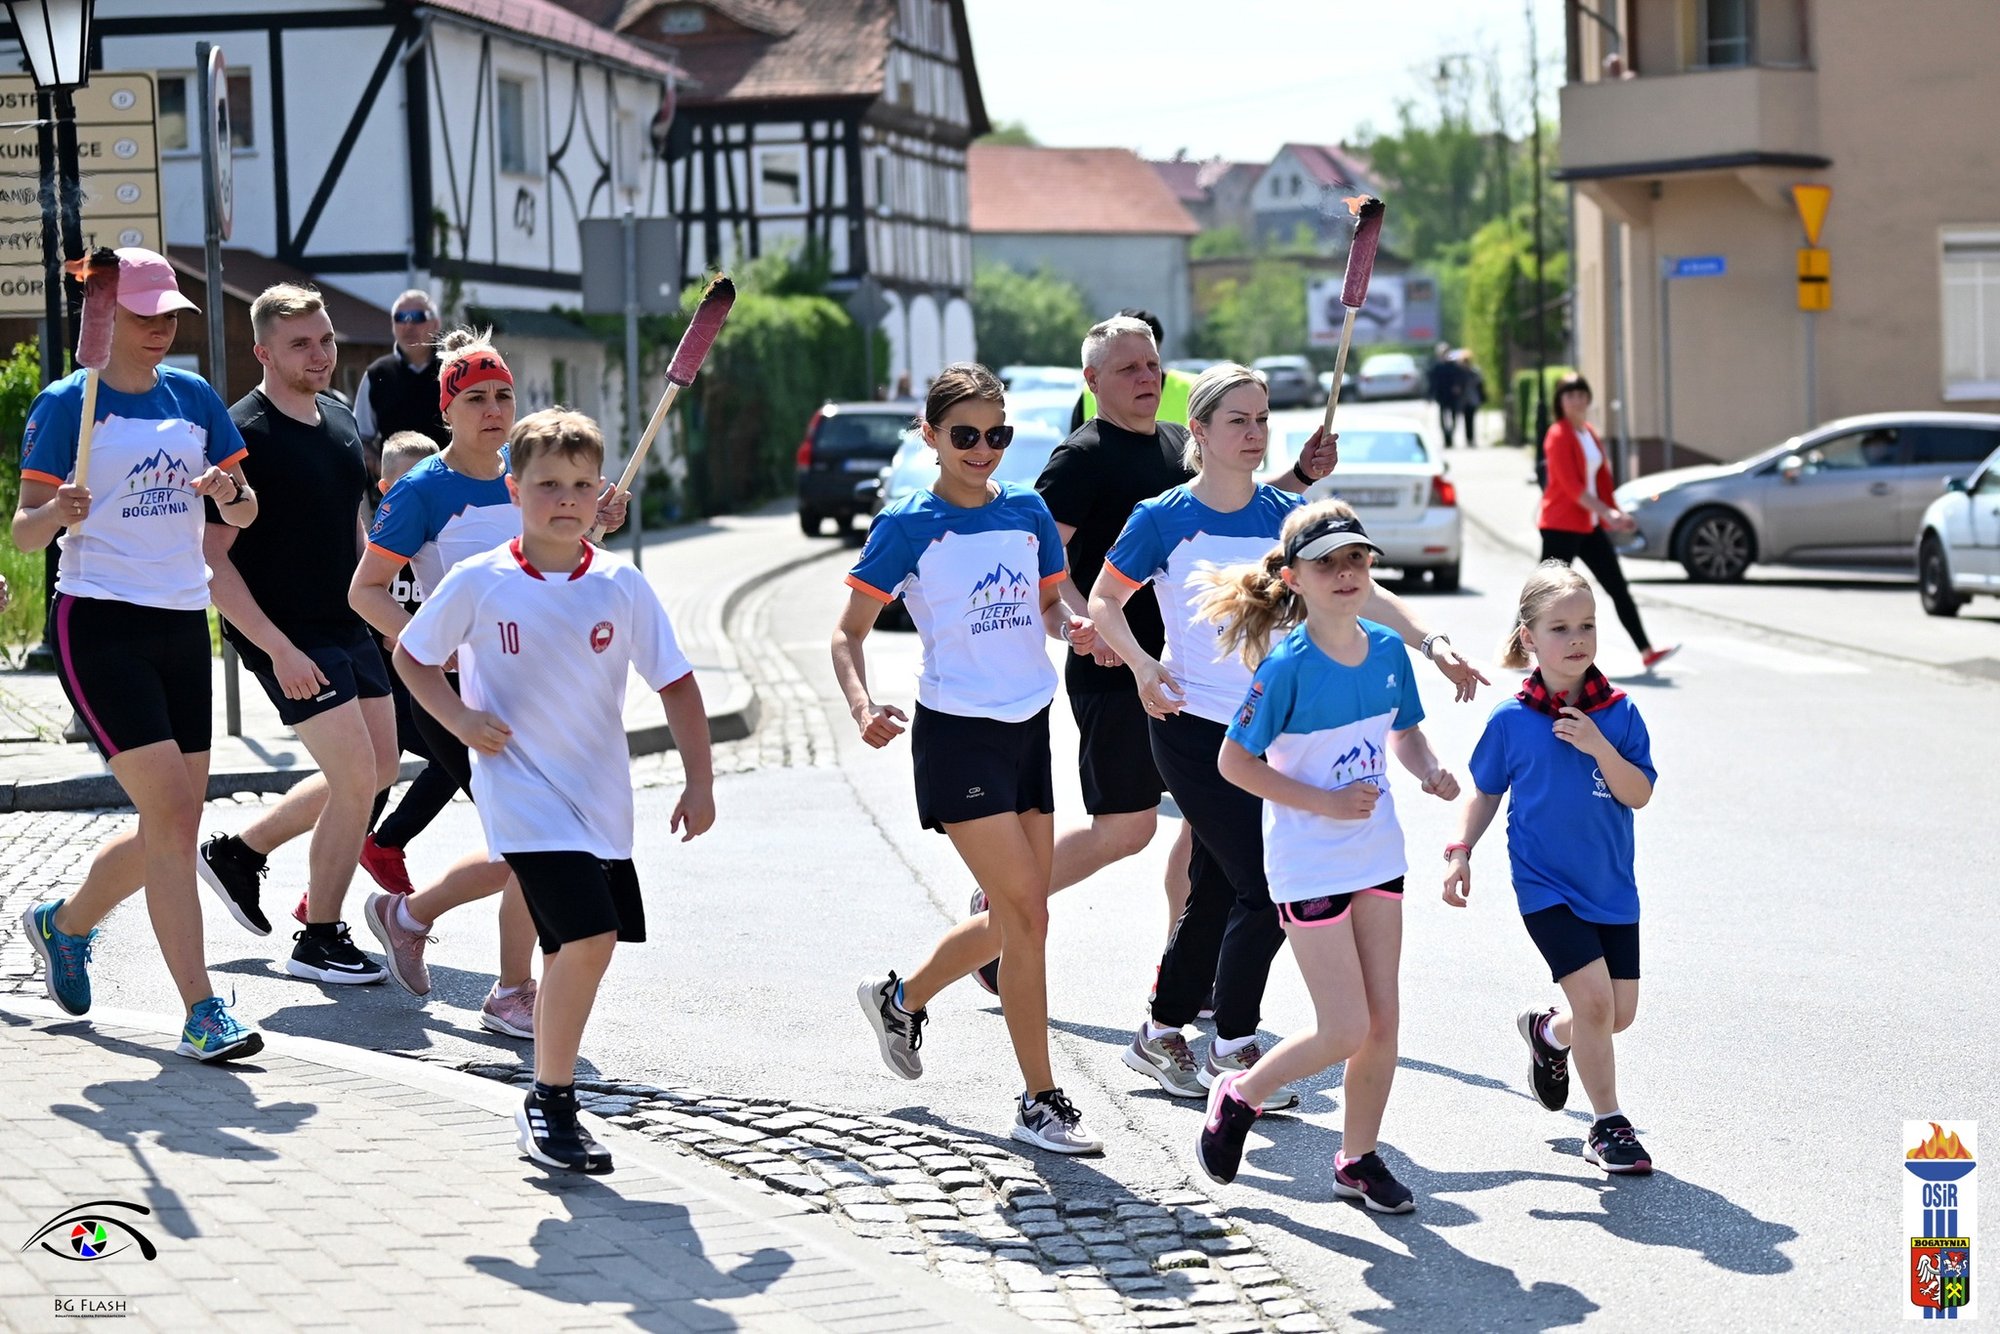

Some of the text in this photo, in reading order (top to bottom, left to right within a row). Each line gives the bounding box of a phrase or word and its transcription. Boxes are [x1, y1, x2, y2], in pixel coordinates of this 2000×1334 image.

[139, 490, 174, 505] IZERY
[122, 502, 189, 518] BOGATYNIA
[980, 604, 1020, 621] IZERY
[497, 622, 520, 655] 10
